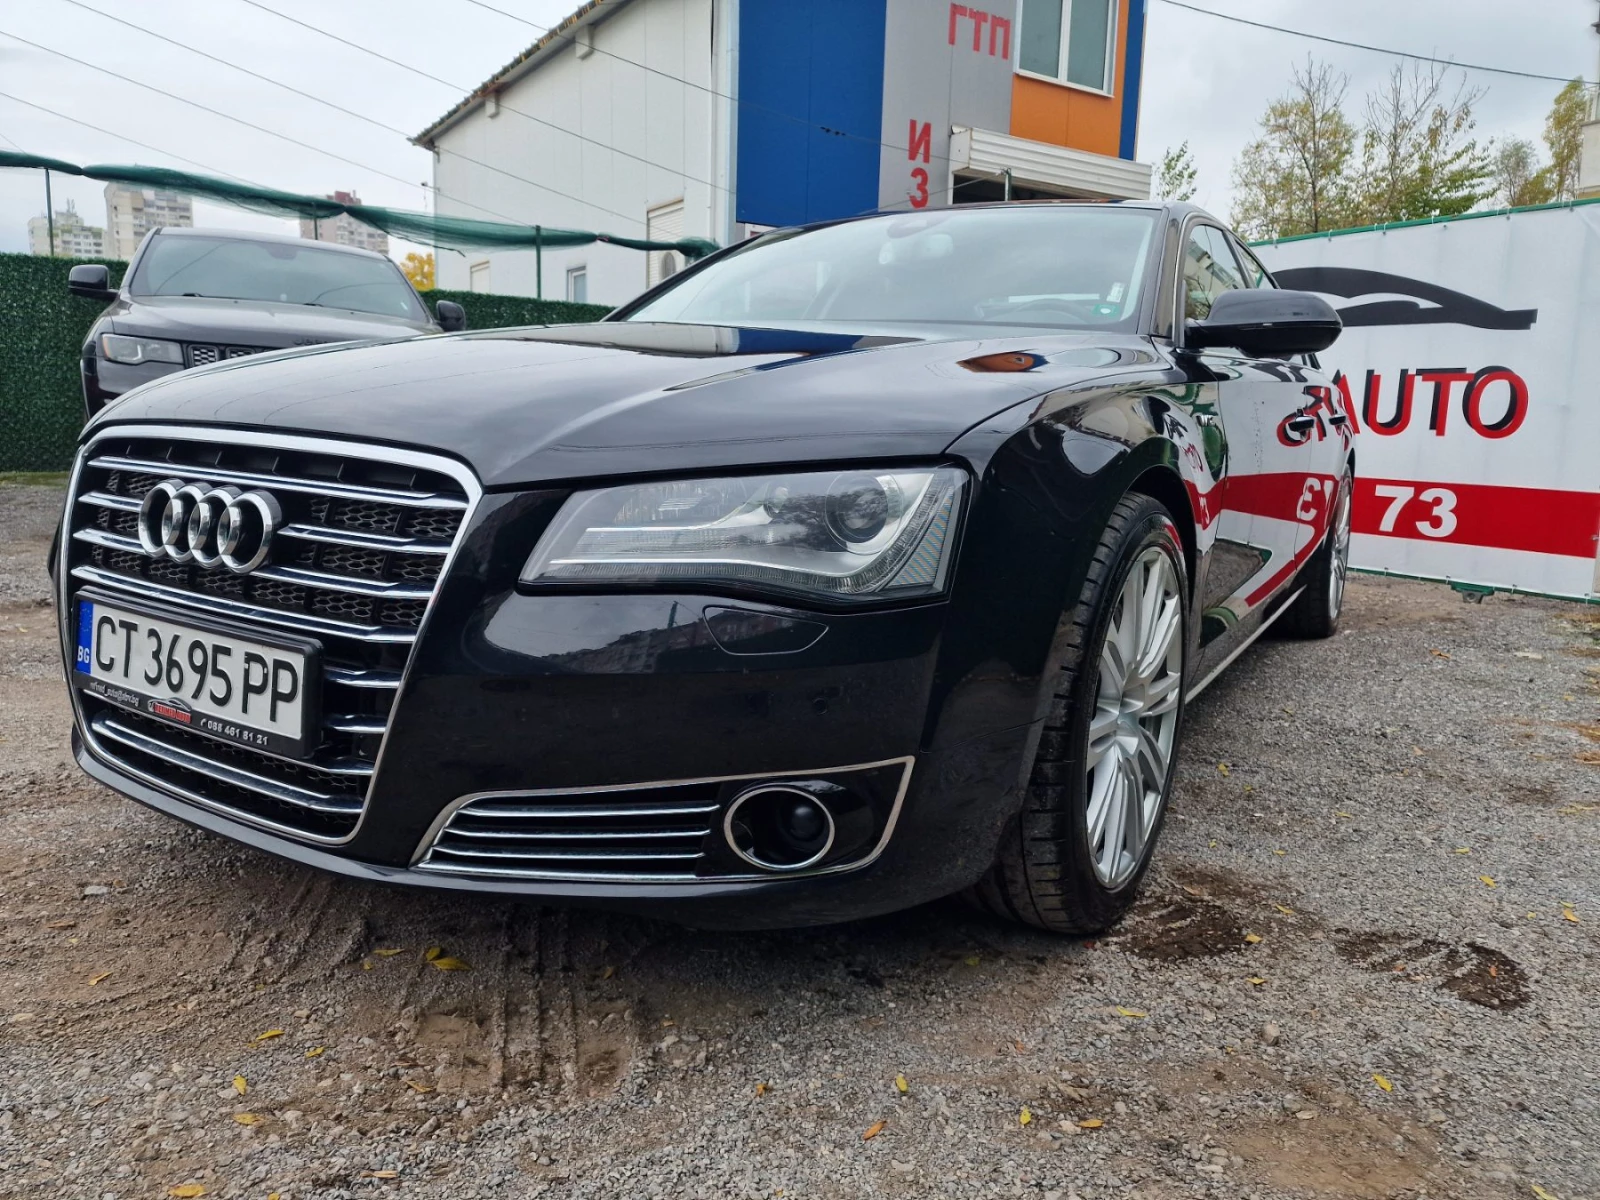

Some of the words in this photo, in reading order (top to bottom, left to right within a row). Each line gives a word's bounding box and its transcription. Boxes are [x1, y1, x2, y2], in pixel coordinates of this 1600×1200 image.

[948, 3, 1010, 60] ГТП
[1374, 485, 1458, 537] 73
[77, 645, 90, 664] BG
[256, 734, 269, 746] 21
